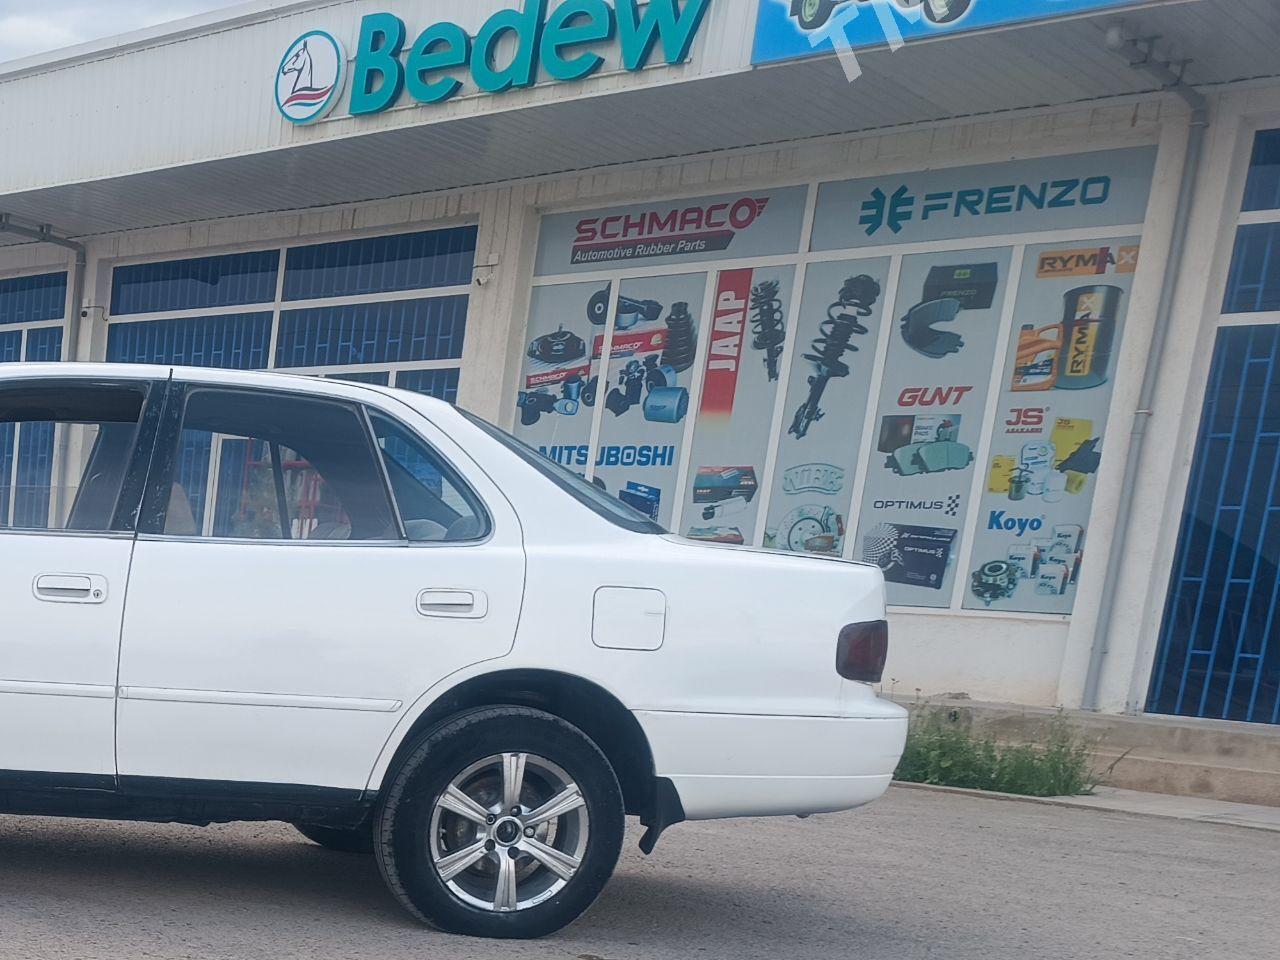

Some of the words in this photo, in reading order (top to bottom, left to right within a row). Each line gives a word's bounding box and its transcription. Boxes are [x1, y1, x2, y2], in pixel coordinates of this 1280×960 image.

[349, 0, 711, 117] Bedew
[921, 176, 1111, 220] FRENZO
[574, 198, 767, 243] SCHMACO
[573, 247, 632, 262] Automotive
[635, 243, 675, 256] Rubber
[677, 239, 706, 252] Parts
[1039, 251, 1137, 270] RYMAX
[708, 290, 746, 371] JAAP
[897, 386, 973, 407] GUNT
[1006, 408, 1044, 426] JS
[873, 500, 944, 509] OPTIMUS
[987, 510, 1042, 537] Koyo
